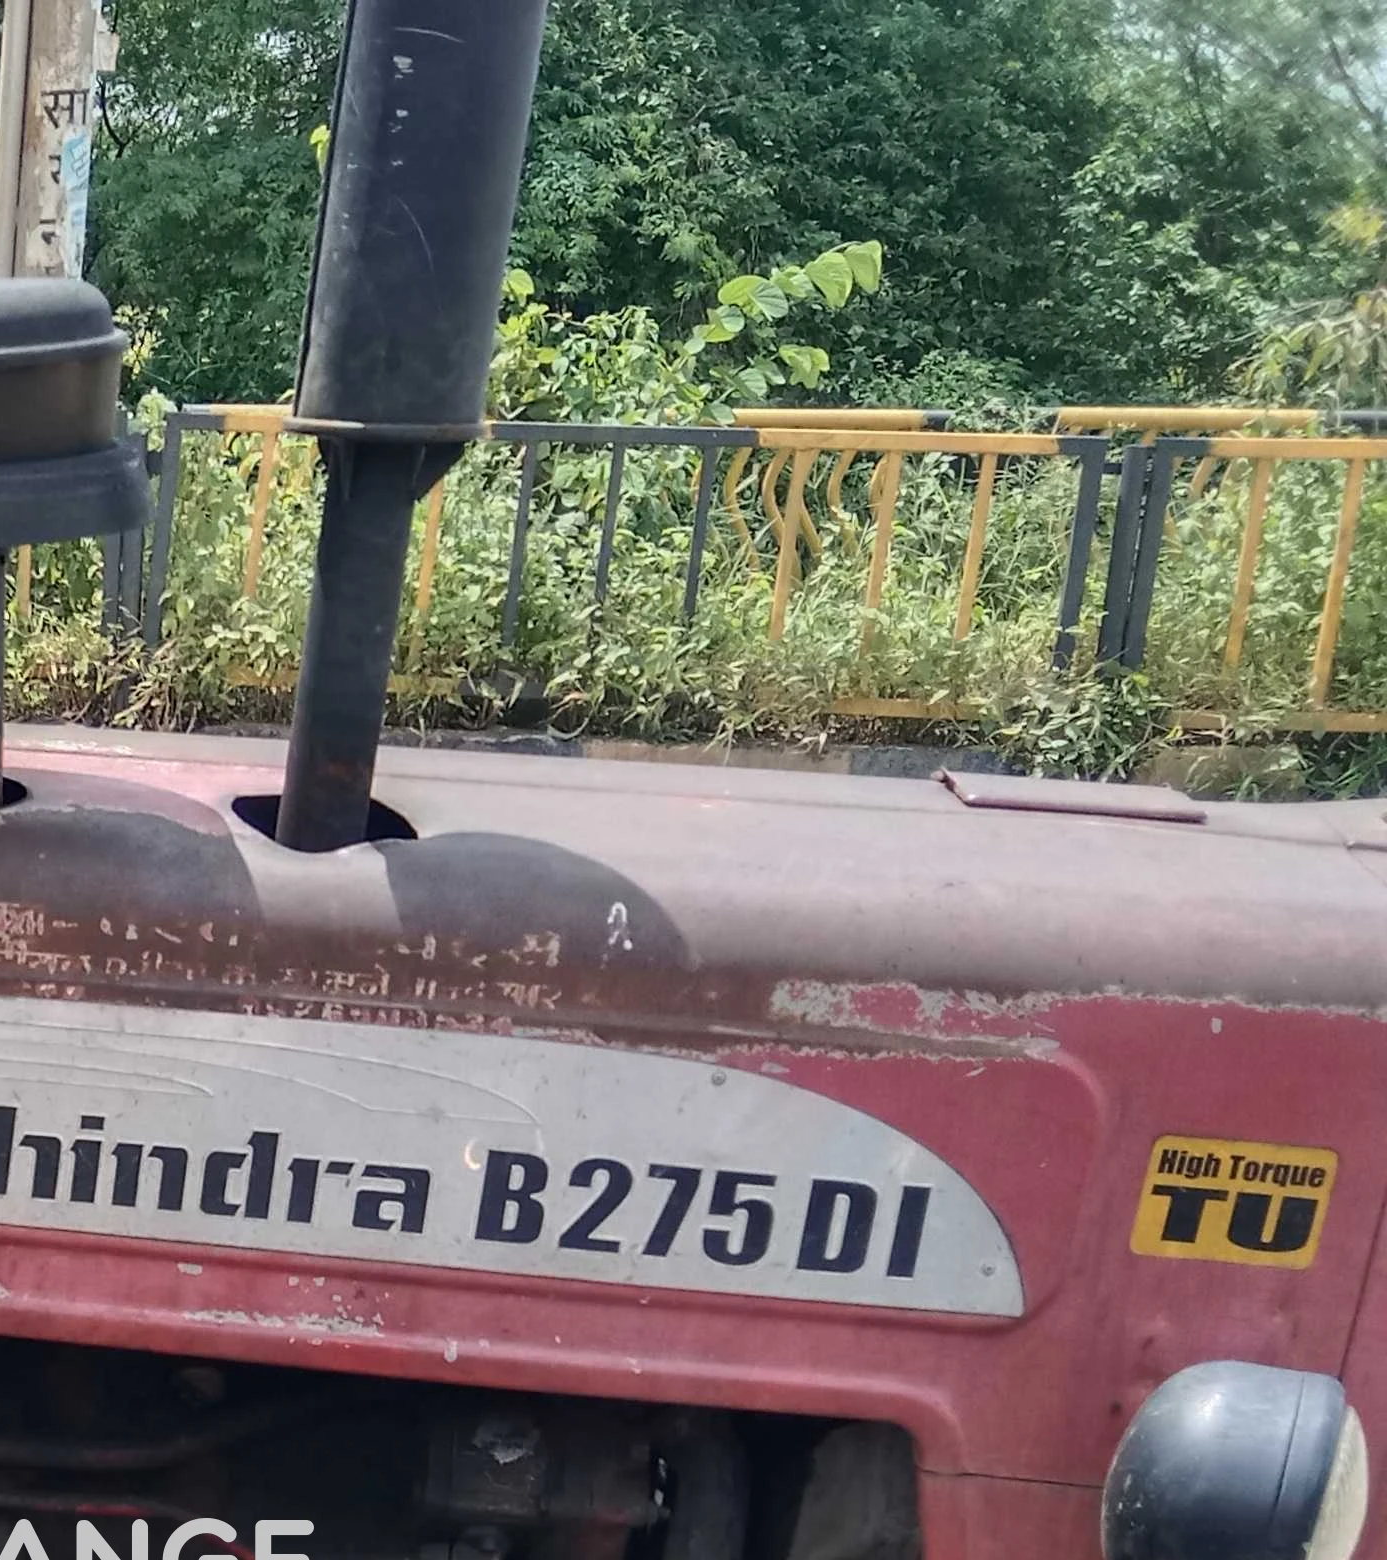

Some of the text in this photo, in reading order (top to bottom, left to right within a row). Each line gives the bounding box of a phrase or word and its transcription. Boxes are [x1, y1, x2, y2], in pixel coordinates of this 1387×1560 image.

[1157, 1149, 1326, 1188] High Torque
[1151, 1184, 1319, 1252] TU
